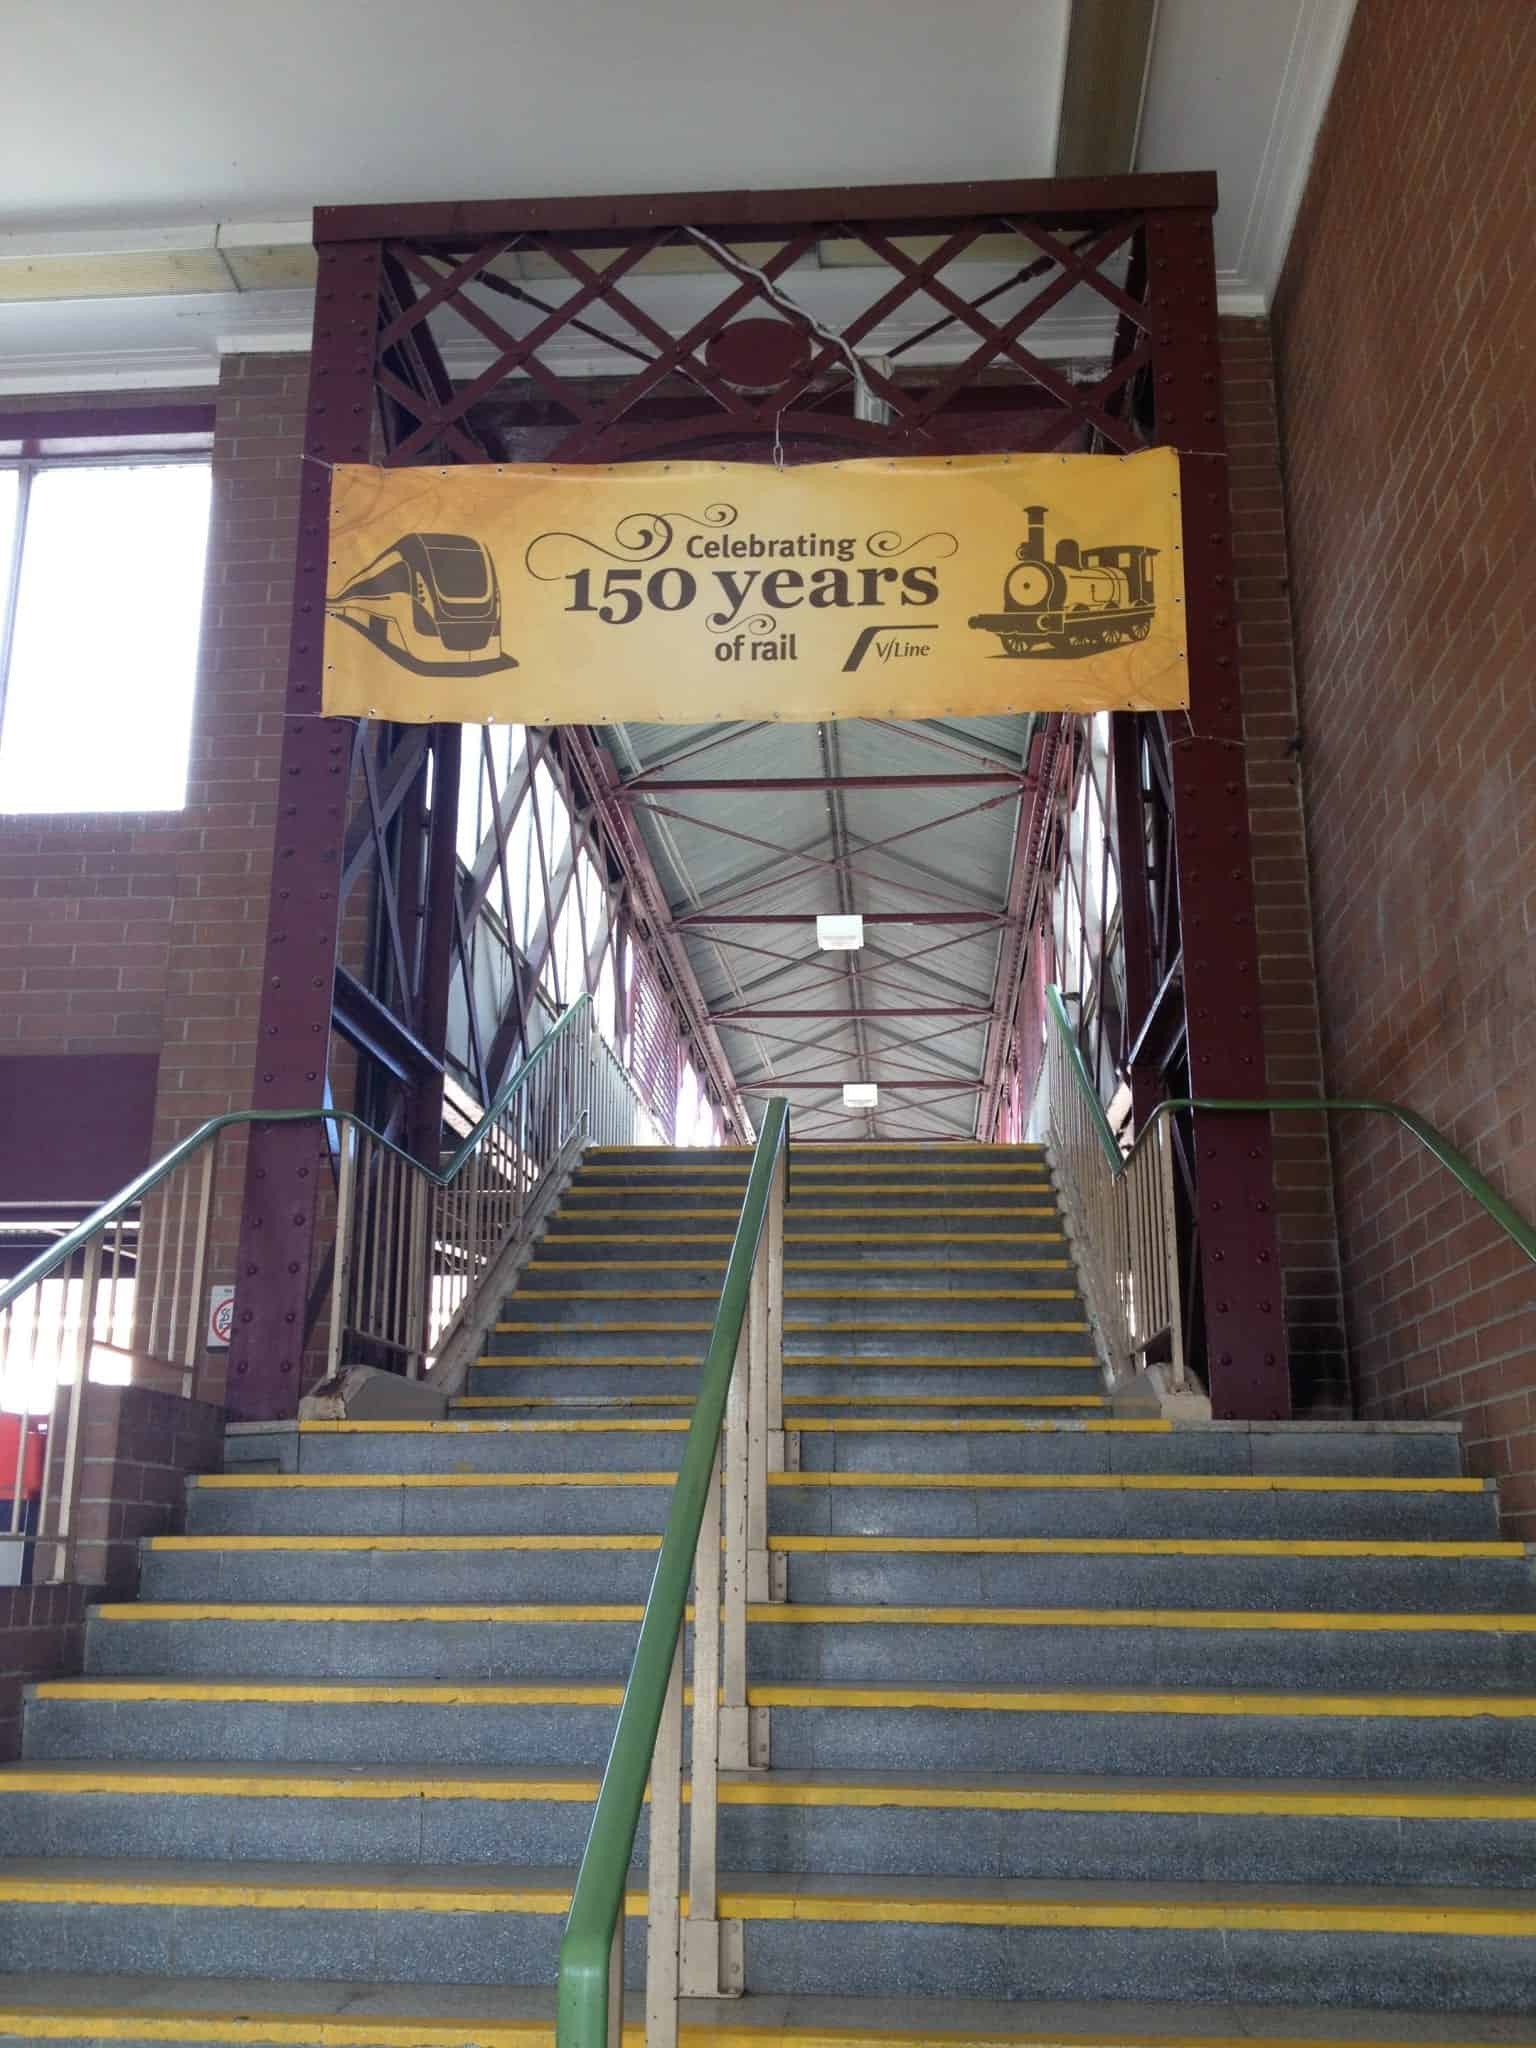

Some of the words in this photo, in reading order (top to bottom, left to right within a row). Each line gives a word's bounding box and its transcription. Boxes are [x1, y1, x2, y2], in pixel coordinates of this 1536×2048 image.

[686, 534, 856, 562] Celebrating
[564, 567, 697, 625] 150
[712, 564, 939, 625] years
[714, 635, 746, 662] of
[751, 634, 798, 660] rail
[875, 637, 930, 659] V/Line
